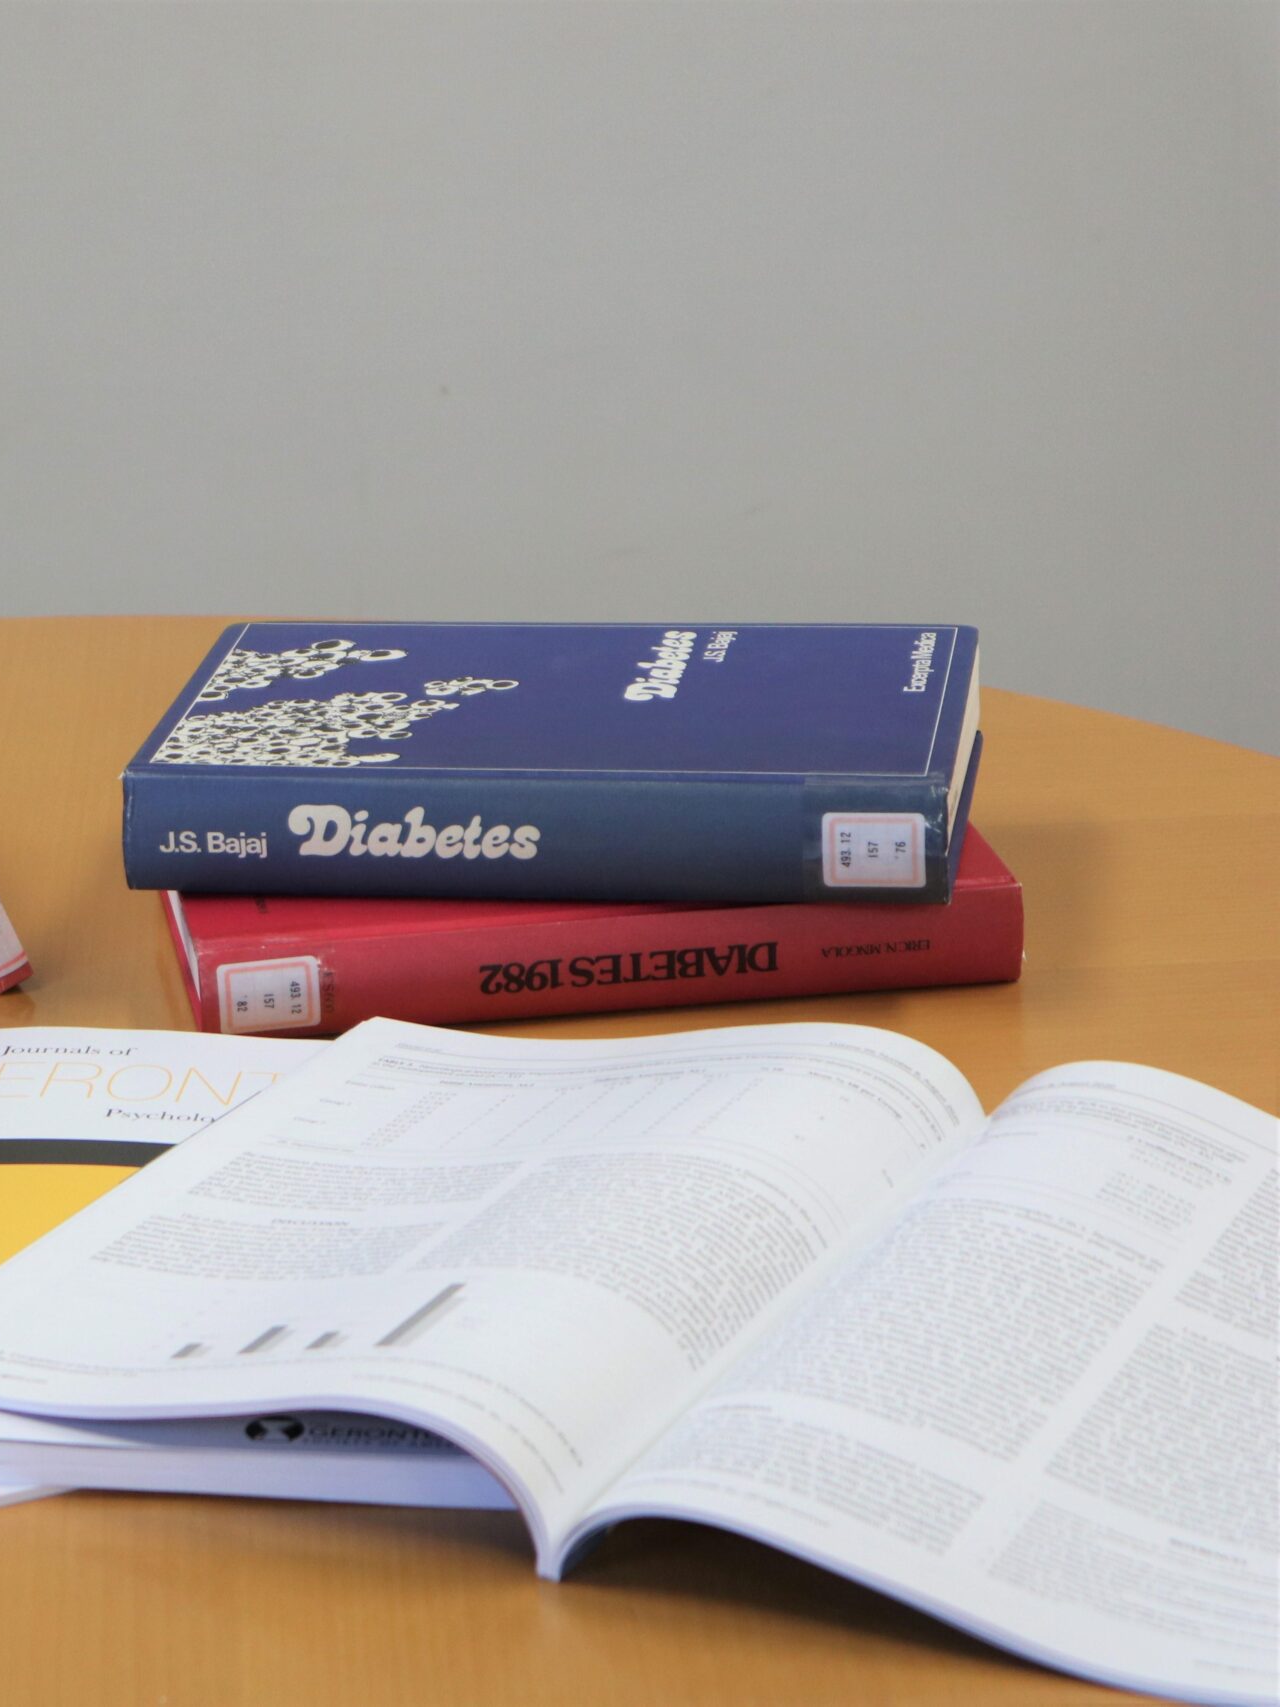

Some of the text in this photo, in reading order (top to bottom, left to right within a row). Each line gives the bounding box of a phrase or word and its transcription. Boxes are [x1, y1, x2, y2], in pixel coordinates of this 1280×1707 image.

[624, 630, 697, 701] Diabetes
[160, 831, 268, 859] J.S. Bajaj
[288, 804, 541, 860] Diabetes
[479, 941, 779, 995] DIABETES 1982
[109, 1046, 138, 1058] of
